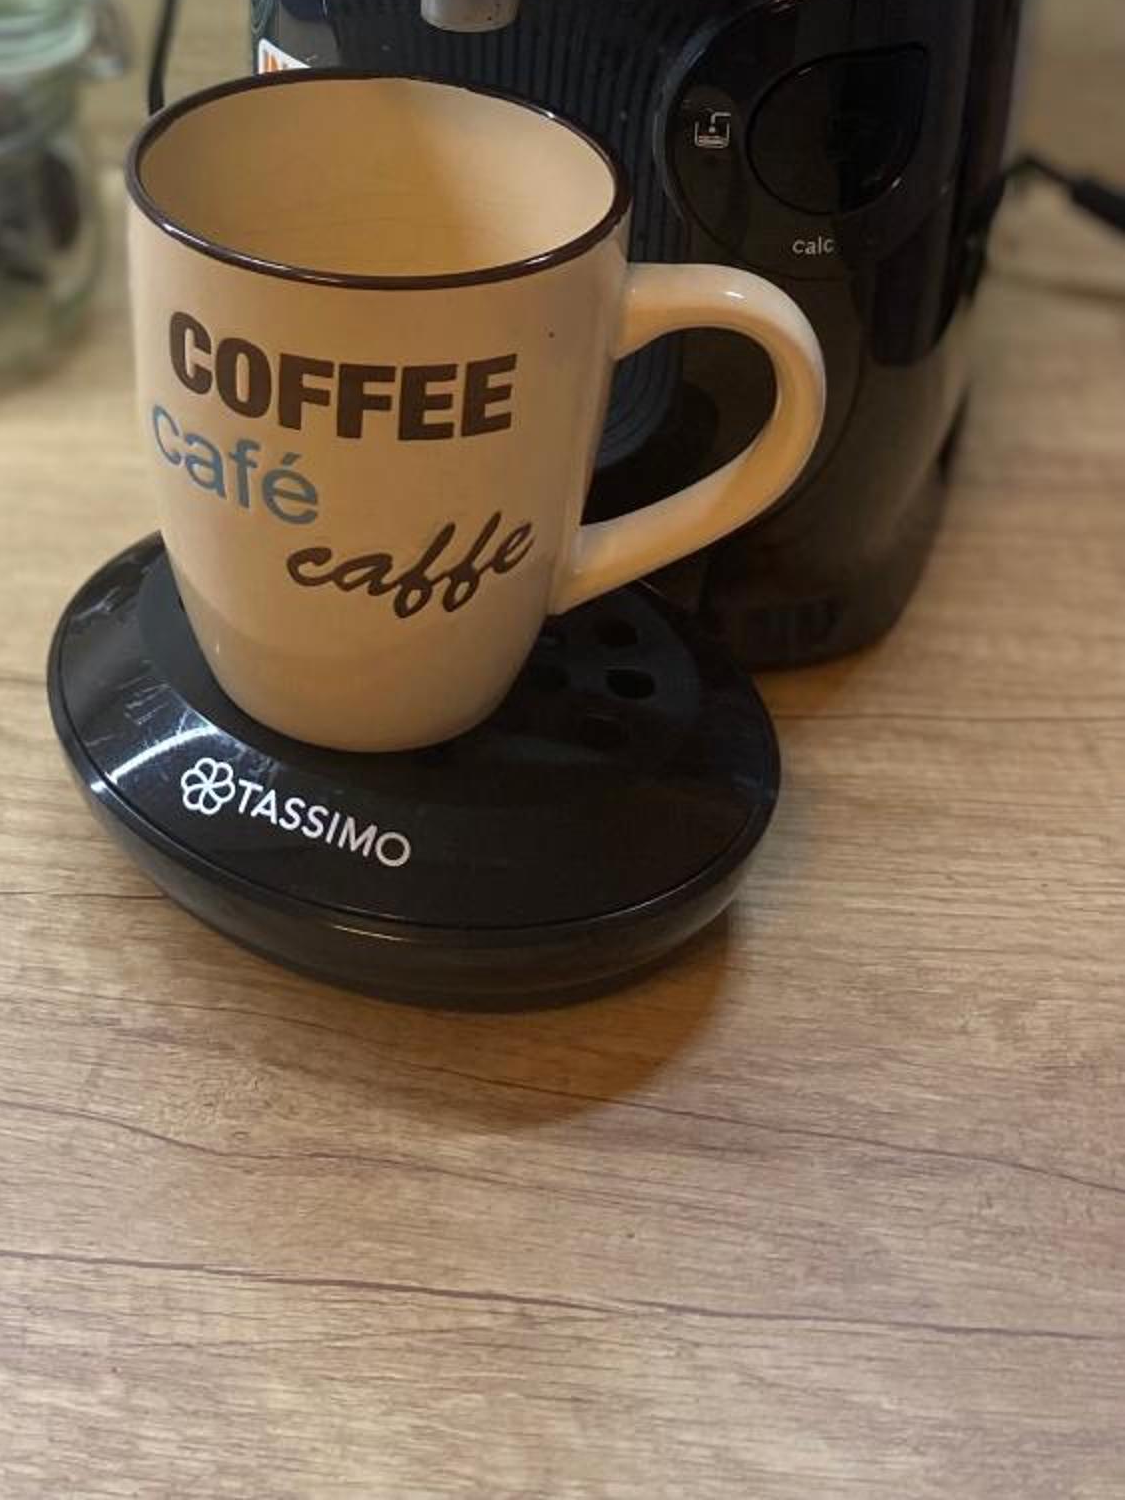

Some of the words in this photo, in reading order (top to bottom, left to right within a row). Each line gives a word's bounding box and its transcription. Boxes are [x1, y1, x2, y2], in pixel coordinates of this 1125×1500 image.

[792, 236, 835, 255] calc
[169, 311, 517, 440] COFFEE
[153, 404, 319, 525] café
[286, 511, 533, 619] caffe
[236, 778, 412, 867] TASSIMO
